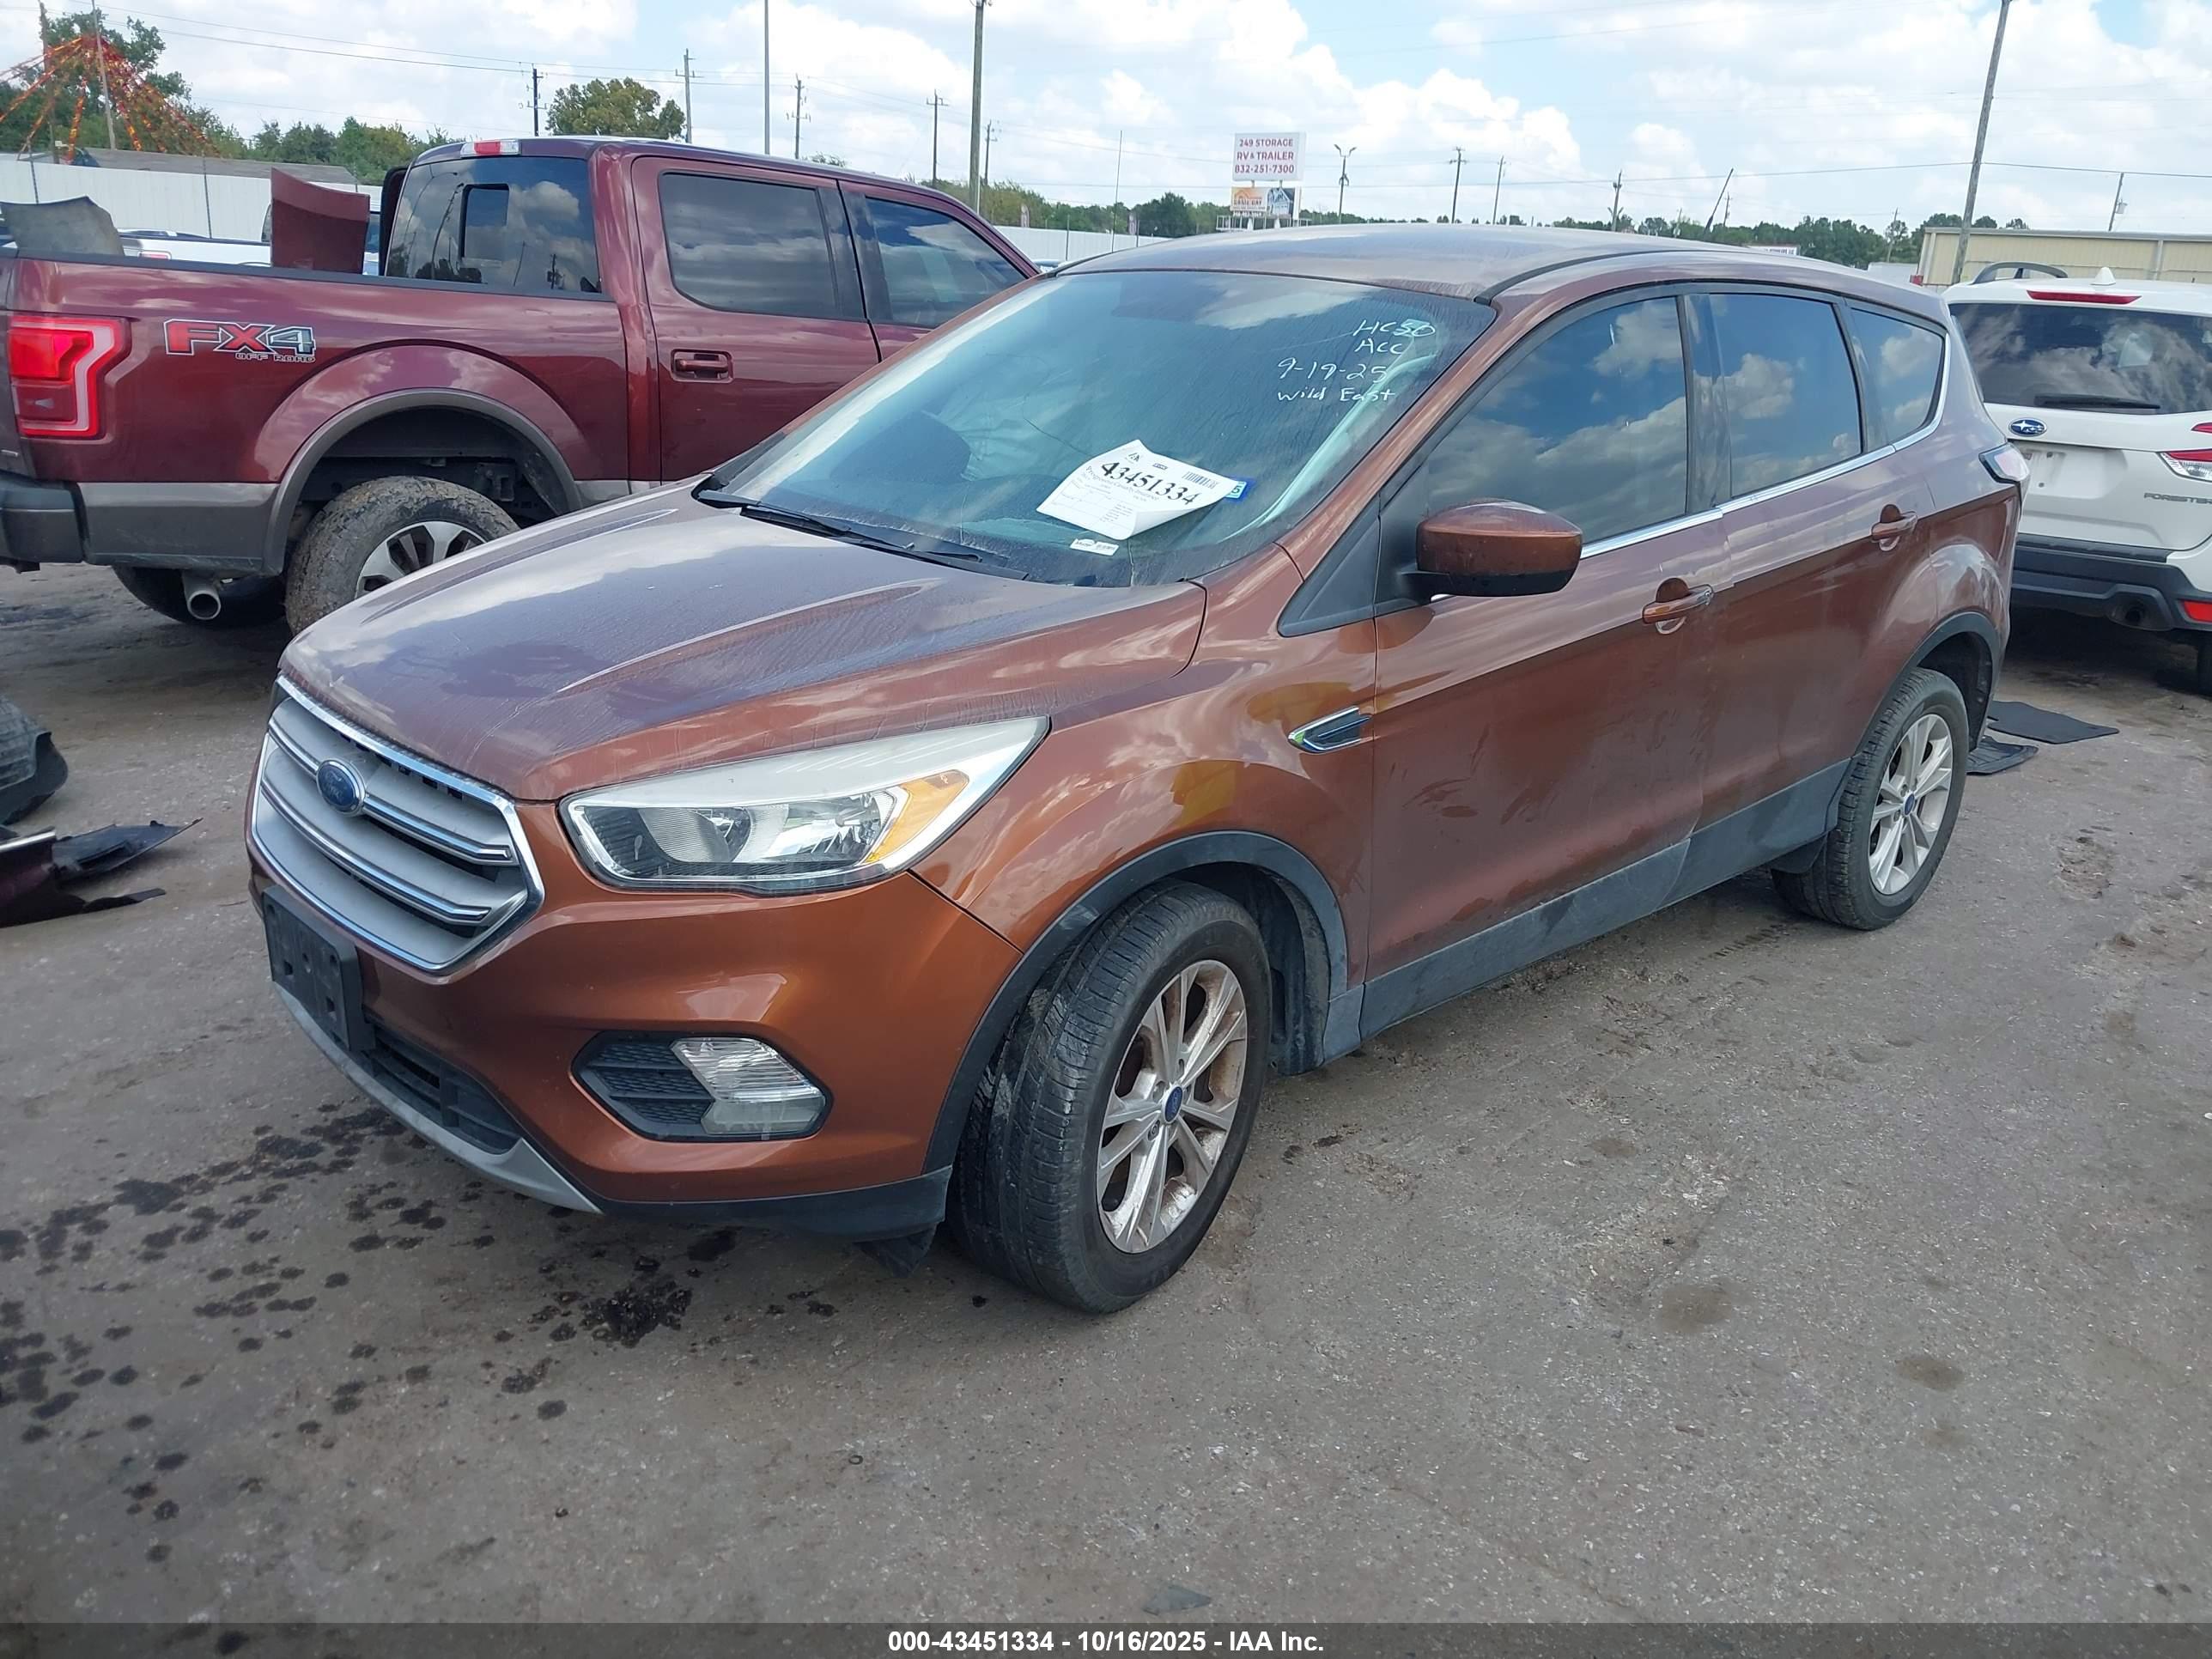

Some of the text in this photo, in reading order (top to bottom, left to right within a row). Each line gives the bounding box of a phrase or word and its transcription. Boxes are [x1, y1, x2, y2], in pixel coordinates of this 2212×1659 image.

[1239, 138, 1293, 147] 249 STORAGE
[1237, 151, 1249, 161] RV
[1257, 151, 1294, 161] TRAILER
[163, 319, 317, 356] FX4
[235, 352, 316, 363] OFF ROAD
[1340, 387, 1395, 402] East
[1101, 462, 1202, 505] 43451334
